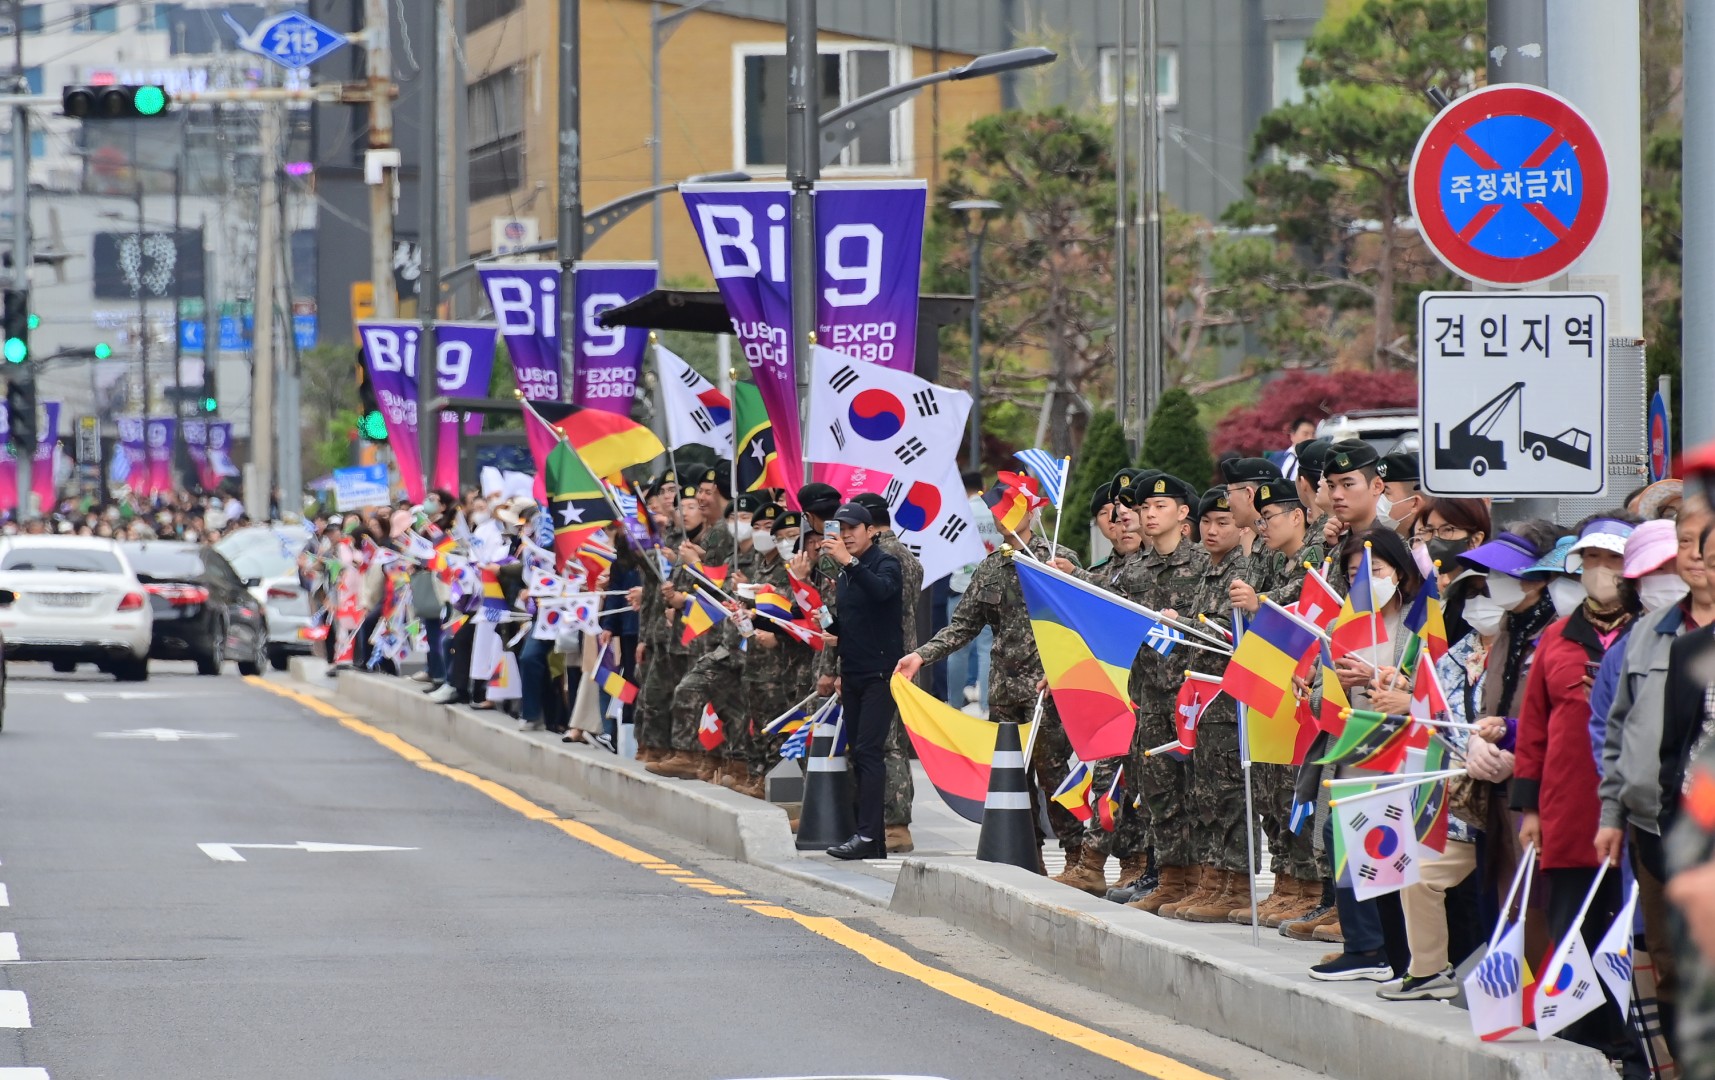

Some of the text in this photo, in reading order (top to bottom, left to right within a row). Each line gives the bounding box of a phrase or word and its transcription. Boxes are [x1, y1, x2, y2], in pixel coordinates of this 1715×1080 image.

[272, 31, 319, 54] 215
[1450, 168, 1574, 204] 주정차금지
[832, 321, 897, 344] EXPO
[1434, 313, 1594, 359] 견인지역
[585, 366, 637, 383] EXPO
[585, 382, 636, 398] 2030
